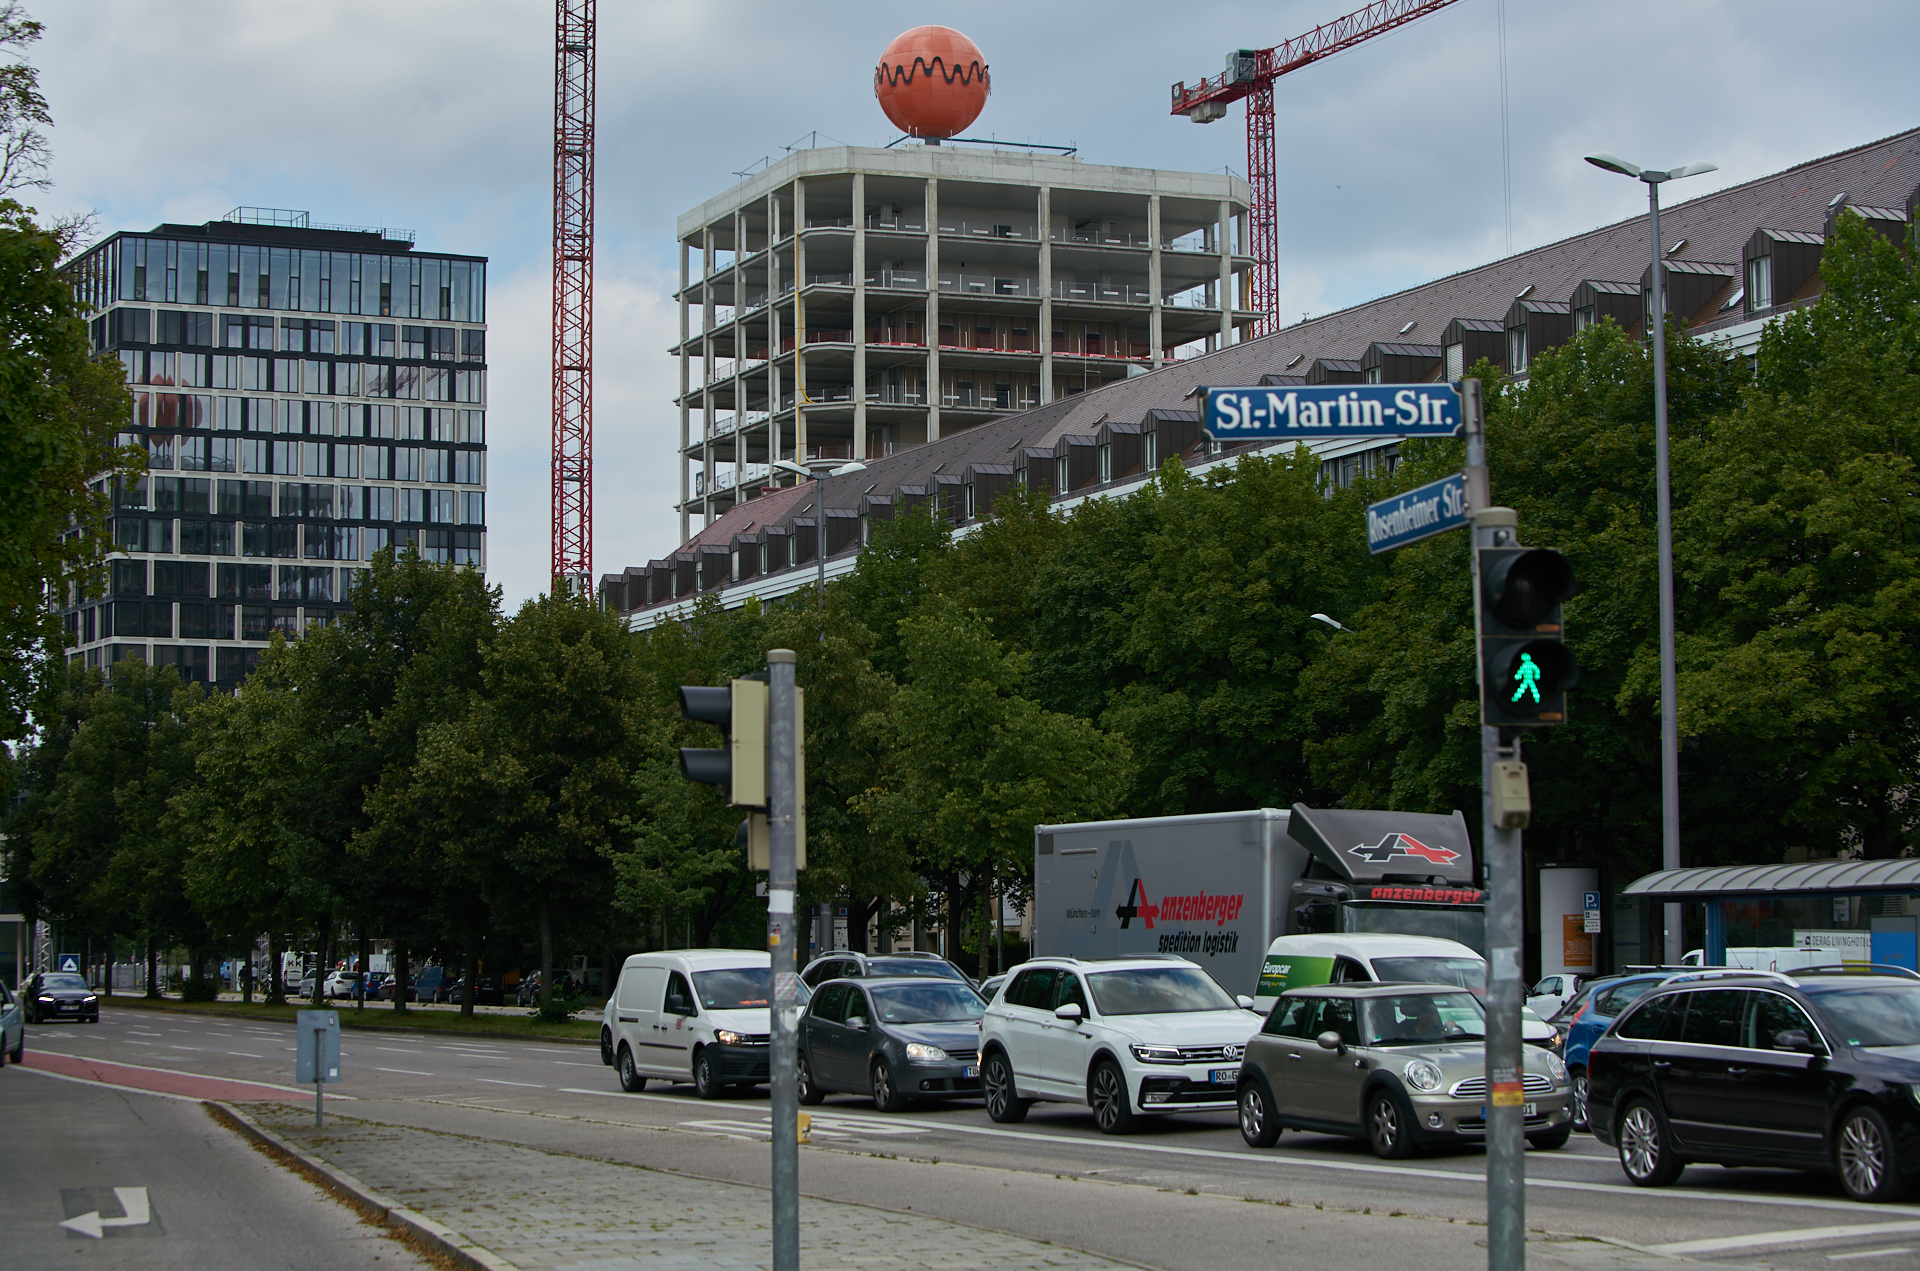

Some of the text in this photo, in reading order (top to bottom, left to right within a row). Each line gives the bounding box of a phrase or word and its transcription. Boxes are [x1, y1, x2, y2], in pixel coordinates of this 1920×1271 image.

[1215, 389, 1454, 430] St.-Martin-Str.
[1368, 482, 1465, 544] Rosenheimer Str.
[1370, 886, 1482, 905] anzenberger
[1585, 893, 1595, 908] P
[1160, 890, 1244, 927] anzenberger
[1157, 930, 1239, 957] spedition logistik
[1812, 935, 1831, 946] DERAG
[1263, 961, 1291, 978] Europcar
